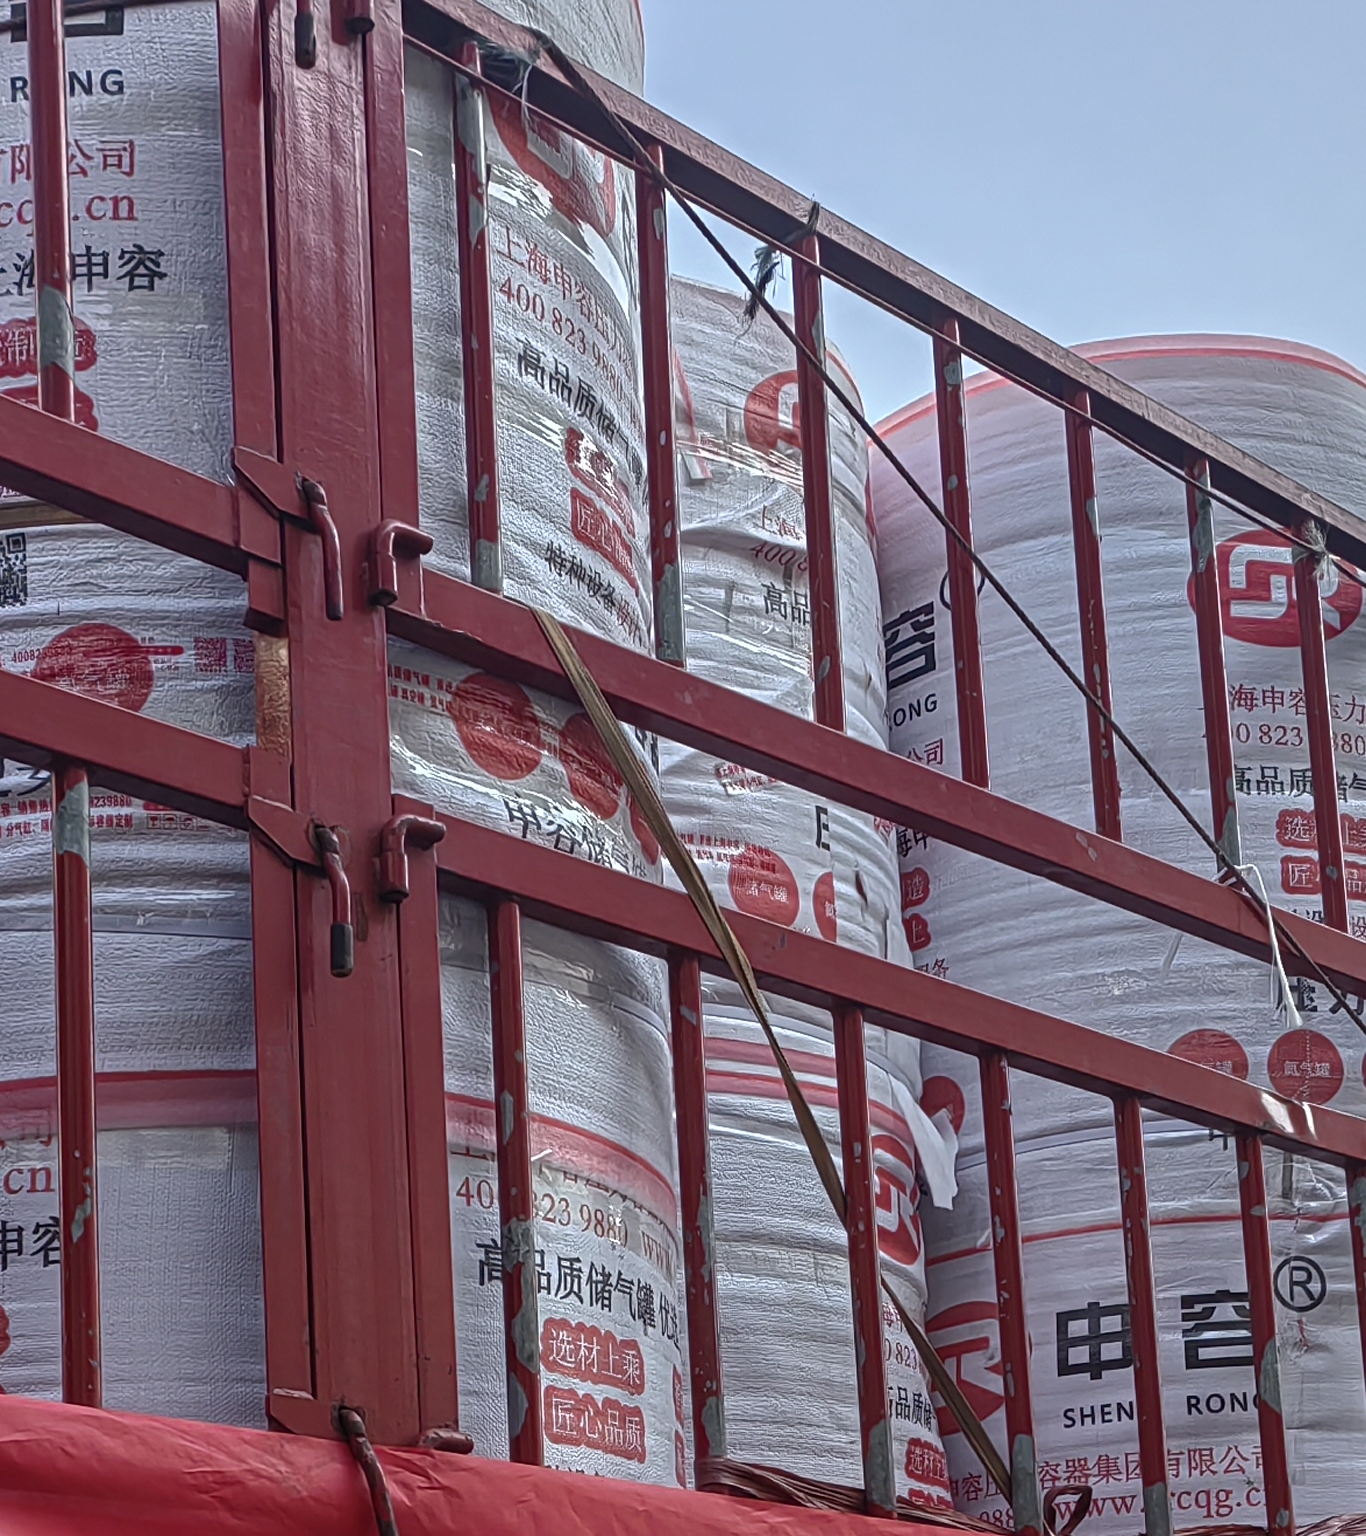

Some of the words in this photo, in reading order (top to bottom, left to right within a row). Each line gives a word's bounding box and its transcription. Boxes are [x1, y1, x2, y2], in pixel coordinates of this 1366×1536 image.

[10, 69, 126, 102] RNG
[499, 277, 545, 322] 400
[552, 307, 586, 355] 823
[1258, 723, 1304, 748] 823
[455, 1176, 495, 1211] 40
[548, 1327, 642, 1386] 选材上乘
[1056, 1289, 1254, 1381] 申容
[552, 1398, 644, 1453] 匠心品质
[1062, 1401, 1136, 1430] SHEN
[1186, 1391, 1260, 1416] RON
